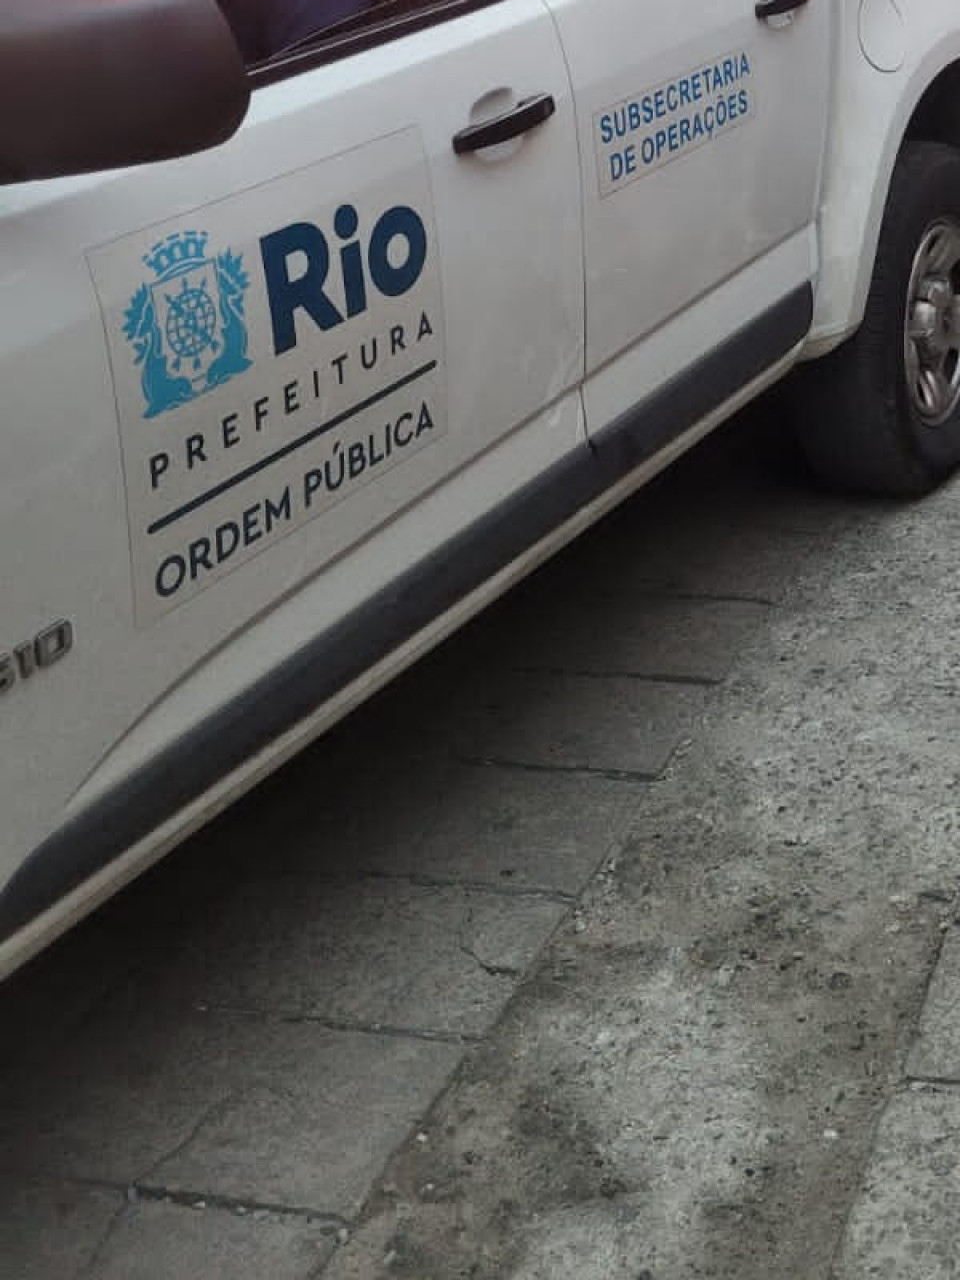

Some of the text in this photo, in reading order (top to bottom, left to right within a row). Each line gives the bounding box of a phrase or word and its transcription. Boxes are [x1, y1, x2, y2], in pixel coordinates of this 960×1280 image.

[599, 51, 751, 145] SUBSECRETARIA
[609, 89, 748, 182] DE OPERAÇÕES
[259, 204, 427, 357] Rio
[148, 311, 434, 489] PREFEITURA
[154, 400, 435, 598] ORDEM PÚBLICA
